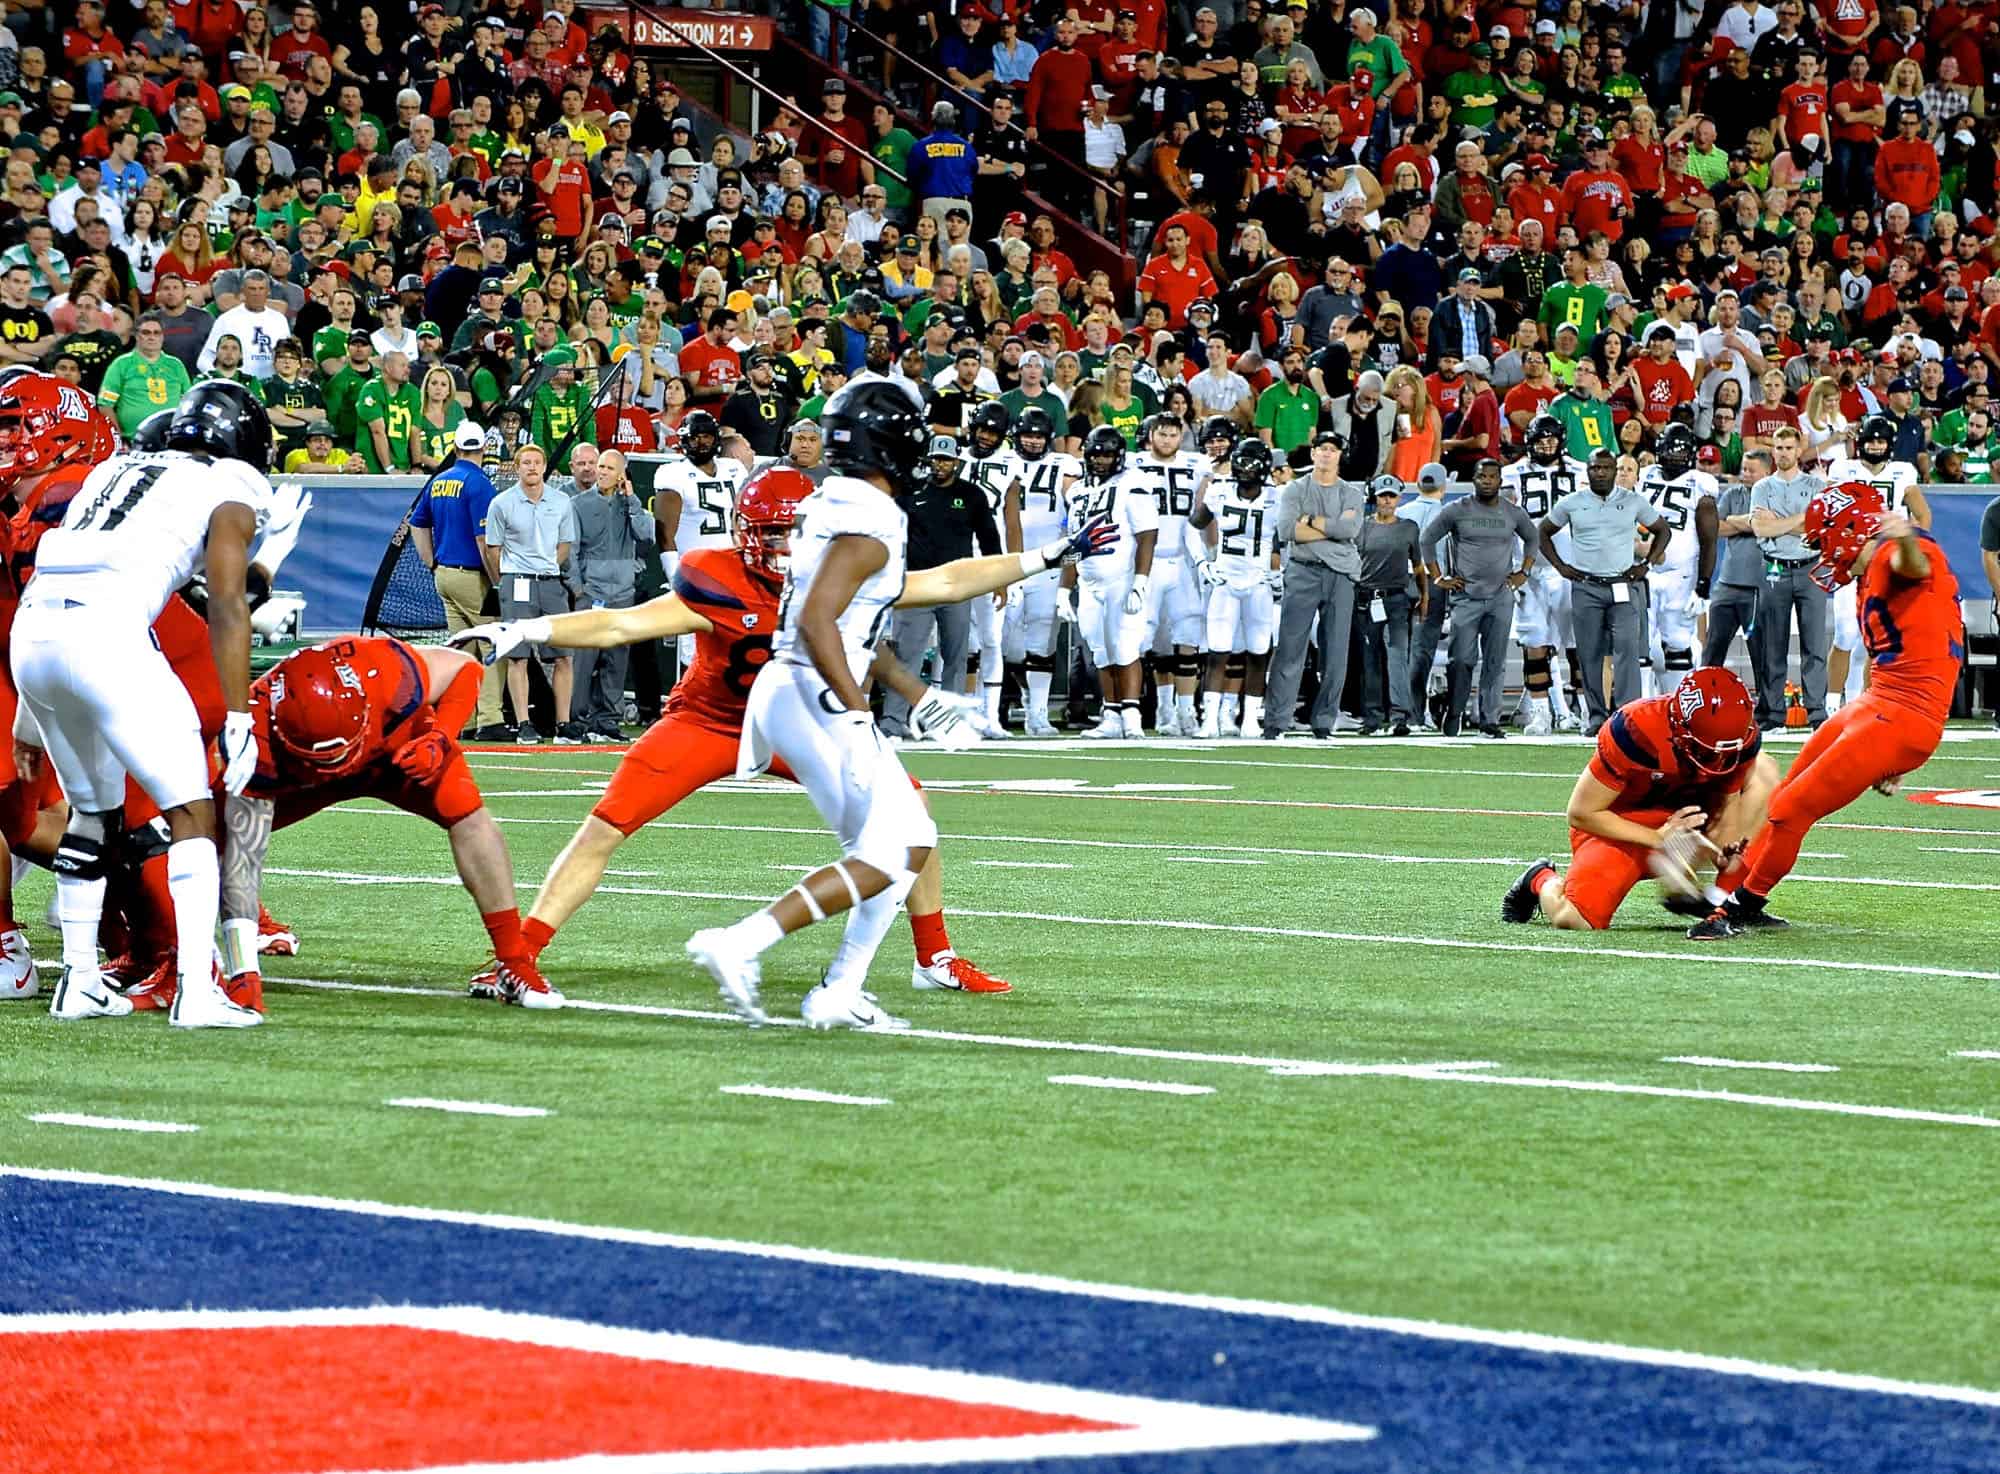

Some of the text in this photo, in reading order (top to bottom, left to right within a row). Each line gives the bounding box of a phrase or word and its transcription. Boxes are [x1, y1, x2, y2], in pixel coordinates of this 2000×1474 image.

[652, 22, 714, 45] SECTION
[719, 25, 735, 46] 21
[926, 143, 966, 158] SECURITY
[1566, 297, 1584, 326] 8
[1582, 416, 1603, 446] 8
[431, 479, 464, 499] SECURITY
[1641, 481, 1692, 531] 75
[1221, 504, 1264, 557] 21
